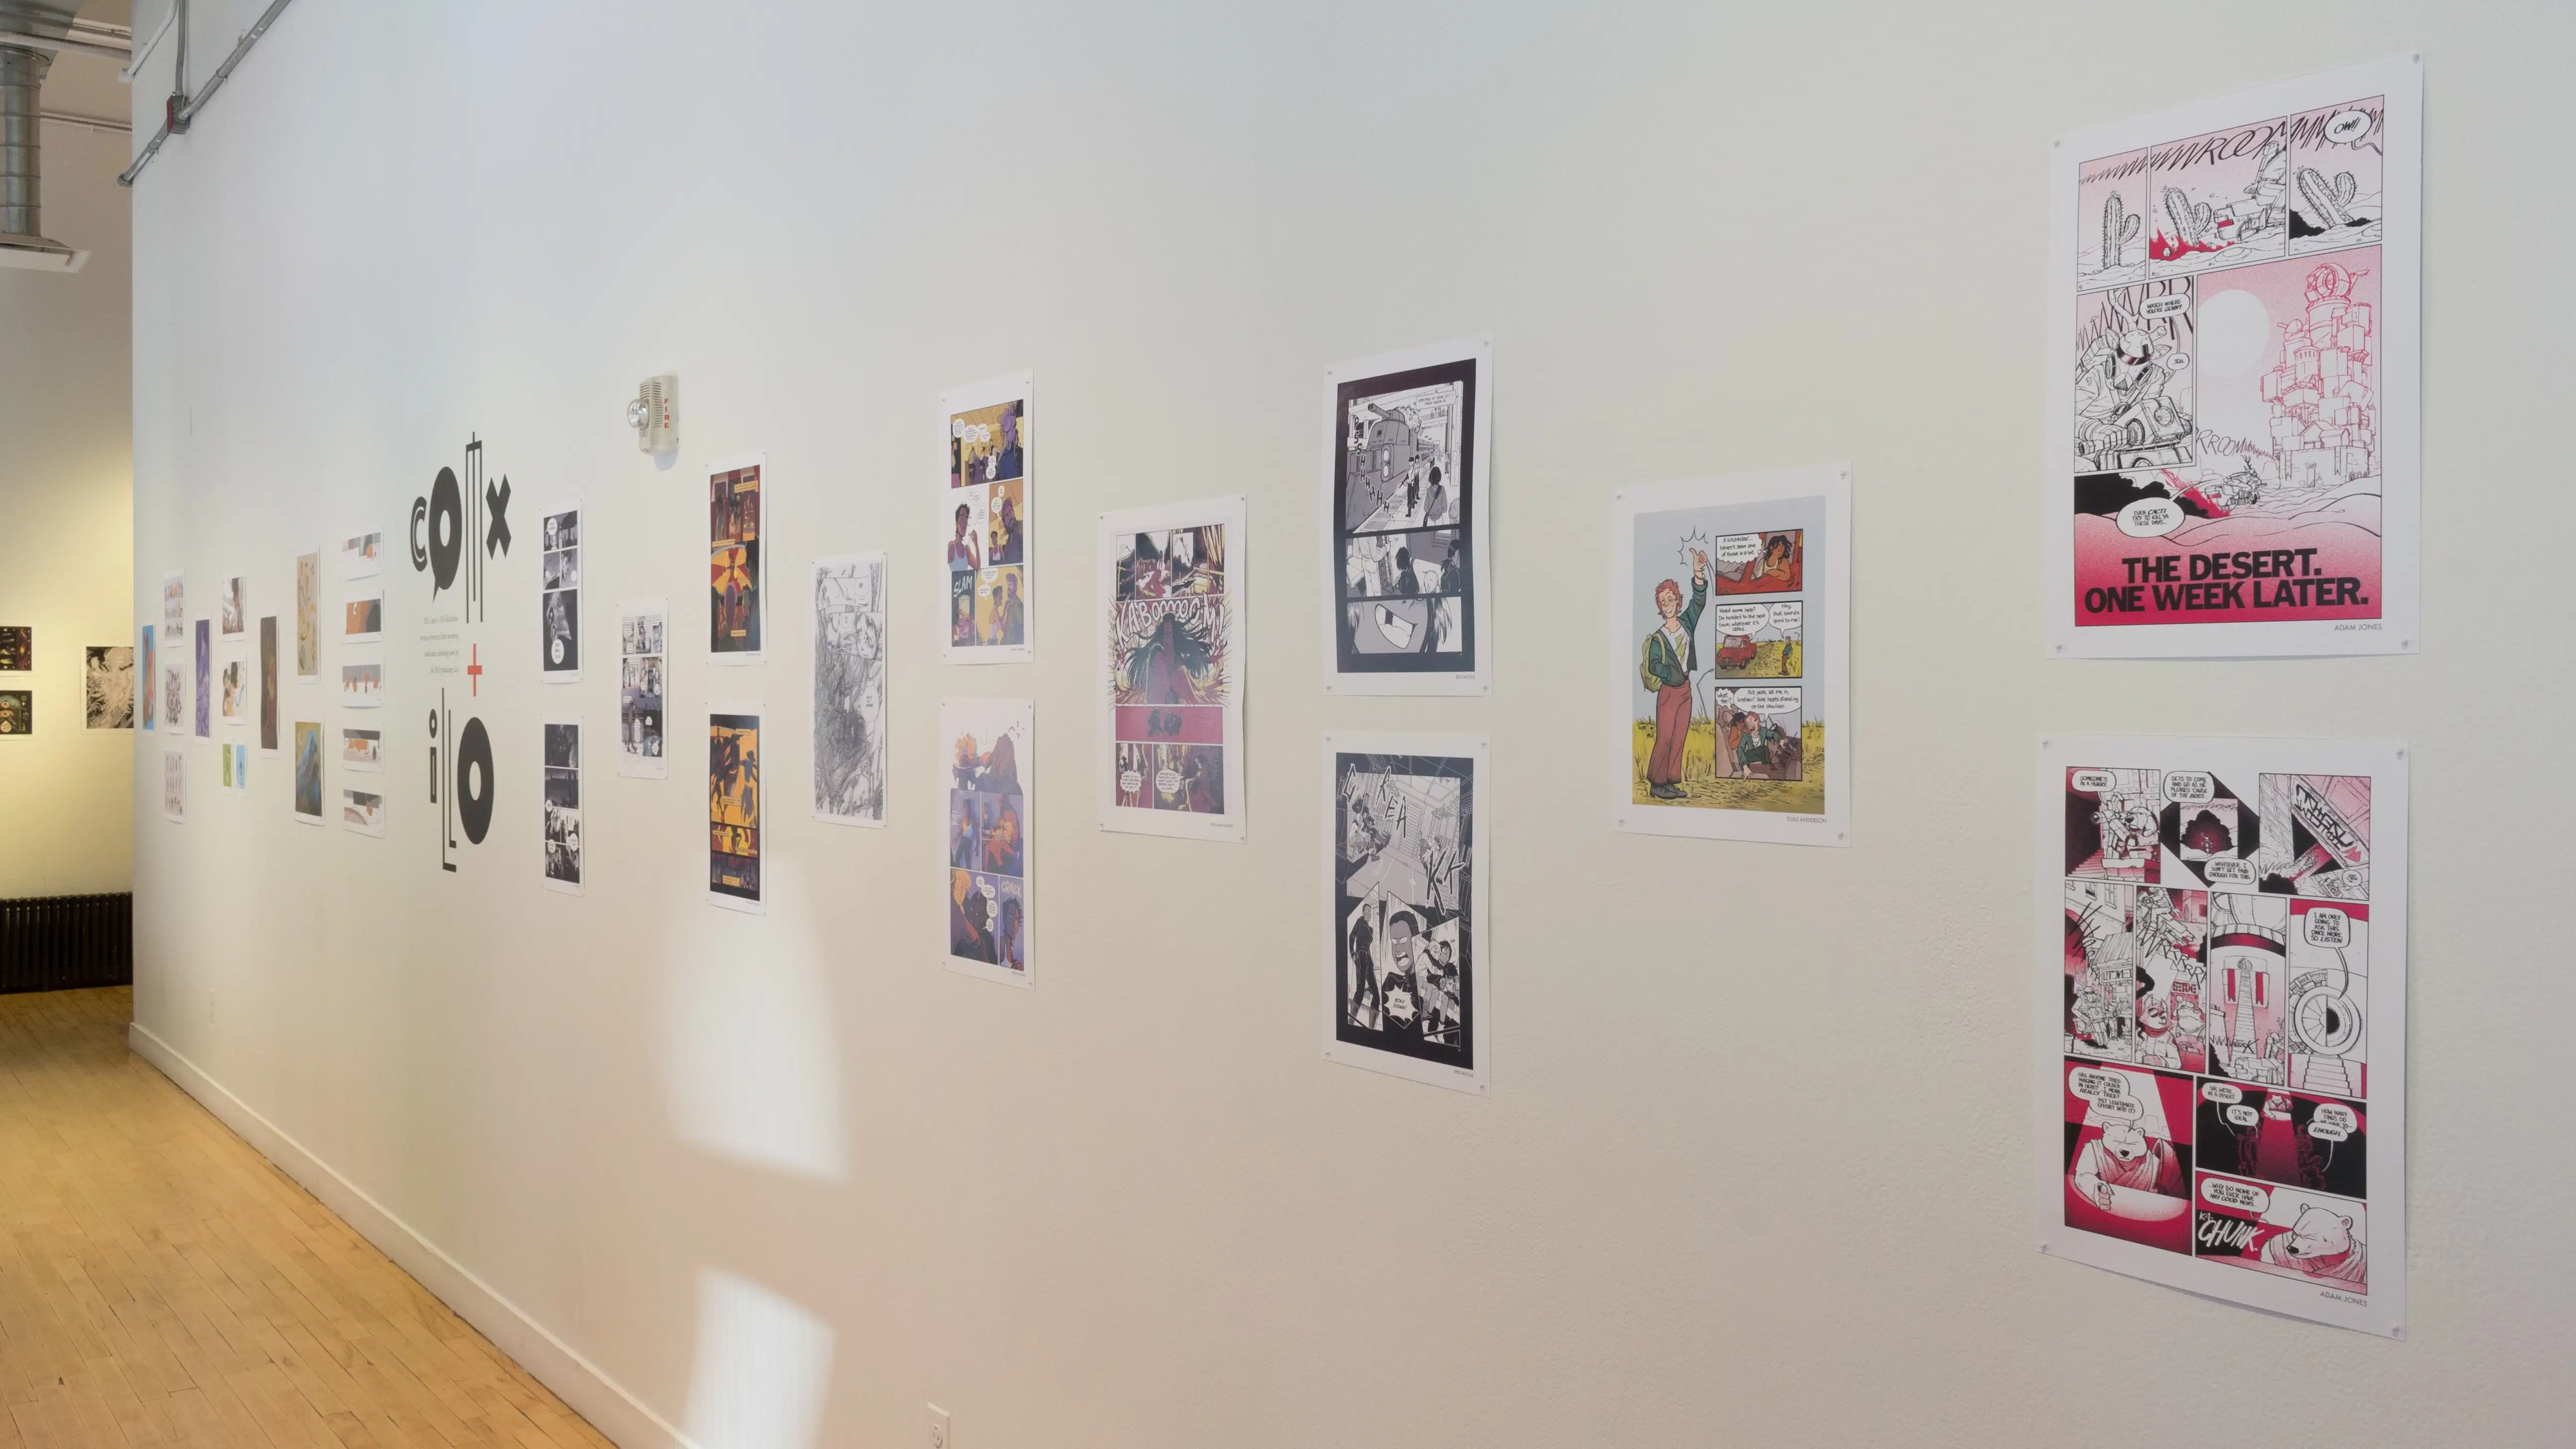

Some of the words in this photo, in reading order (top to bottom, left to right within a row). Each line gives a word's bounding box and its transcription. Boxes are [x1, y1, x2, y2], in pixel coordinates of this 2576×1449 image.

[2122, 556, 2180, 583] THE
[2189, 548, 2322, 579] DESERT.
[954, 575, 972, 598] SLAM
[2085, 585, 2145, 614] ONE
[2152, 580, 2245, 611] WEEK
[2253, 577, 2369, 608] LATER.
[1001, 881, 1022, 898] CRACK
[2320, 1291, 2341, 1301] ADAM
[2343, 1296, 2368, 1307] JONES
